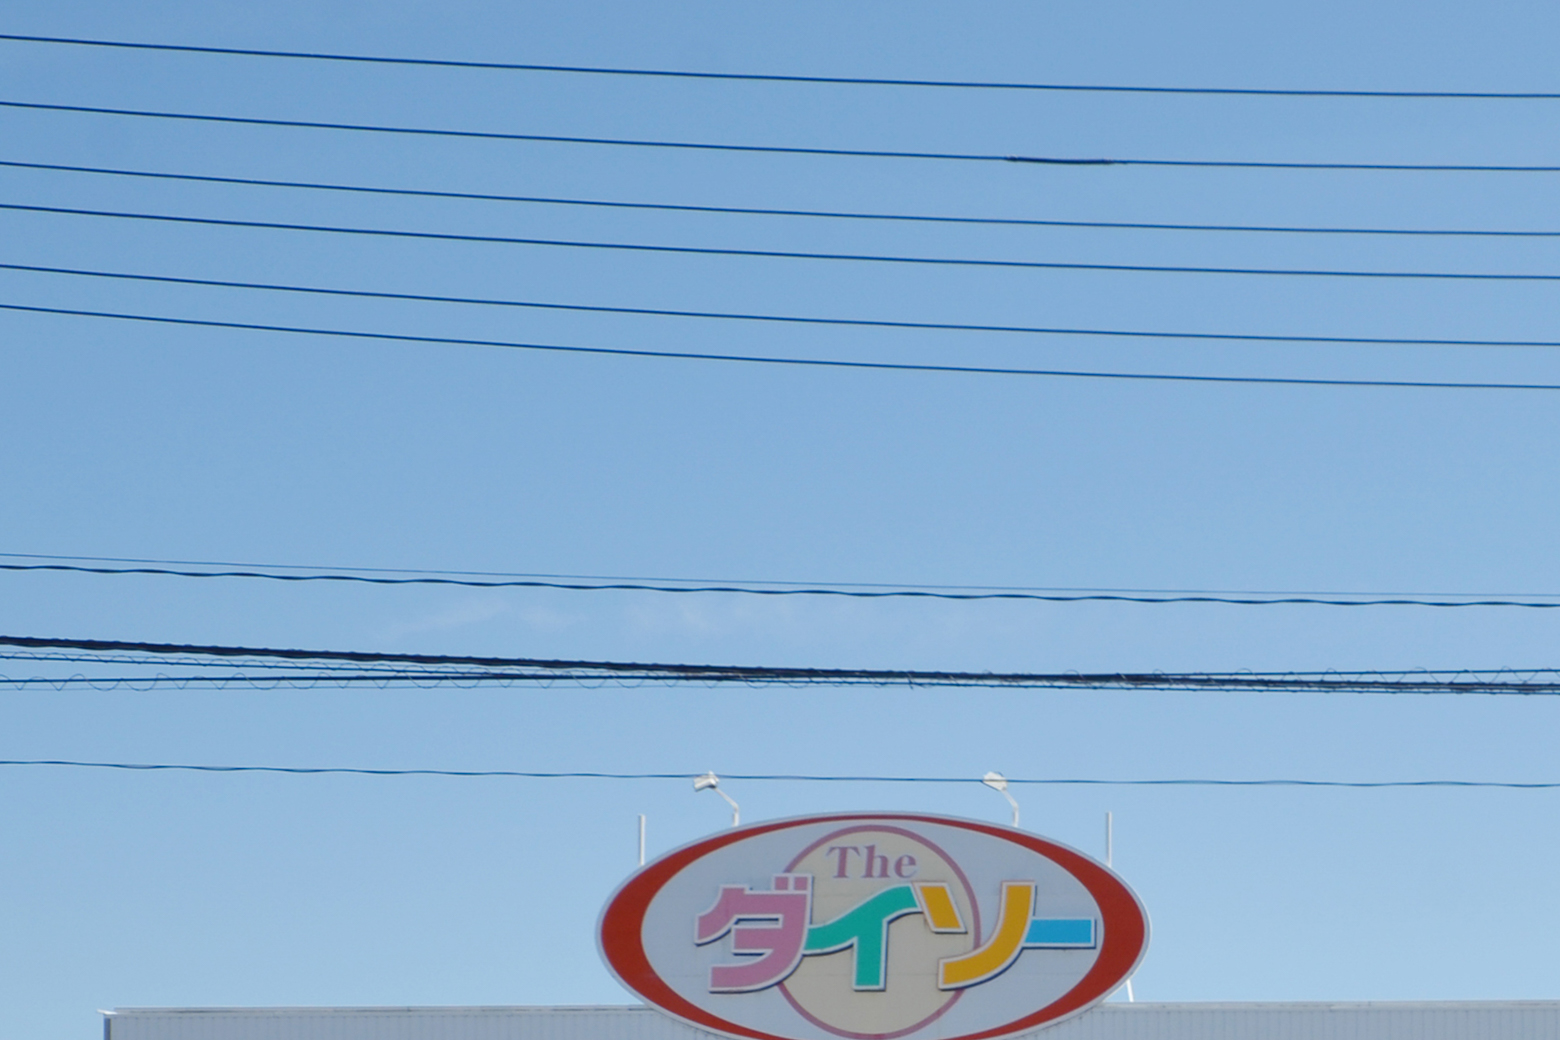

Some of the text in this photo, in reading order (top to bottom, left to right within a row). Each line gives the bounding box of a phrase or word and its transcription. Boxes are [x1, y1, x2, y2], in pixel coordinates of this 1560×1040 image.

[825, 844, 919, 879] The
[694, 873, 1097, 993] ダイソー
